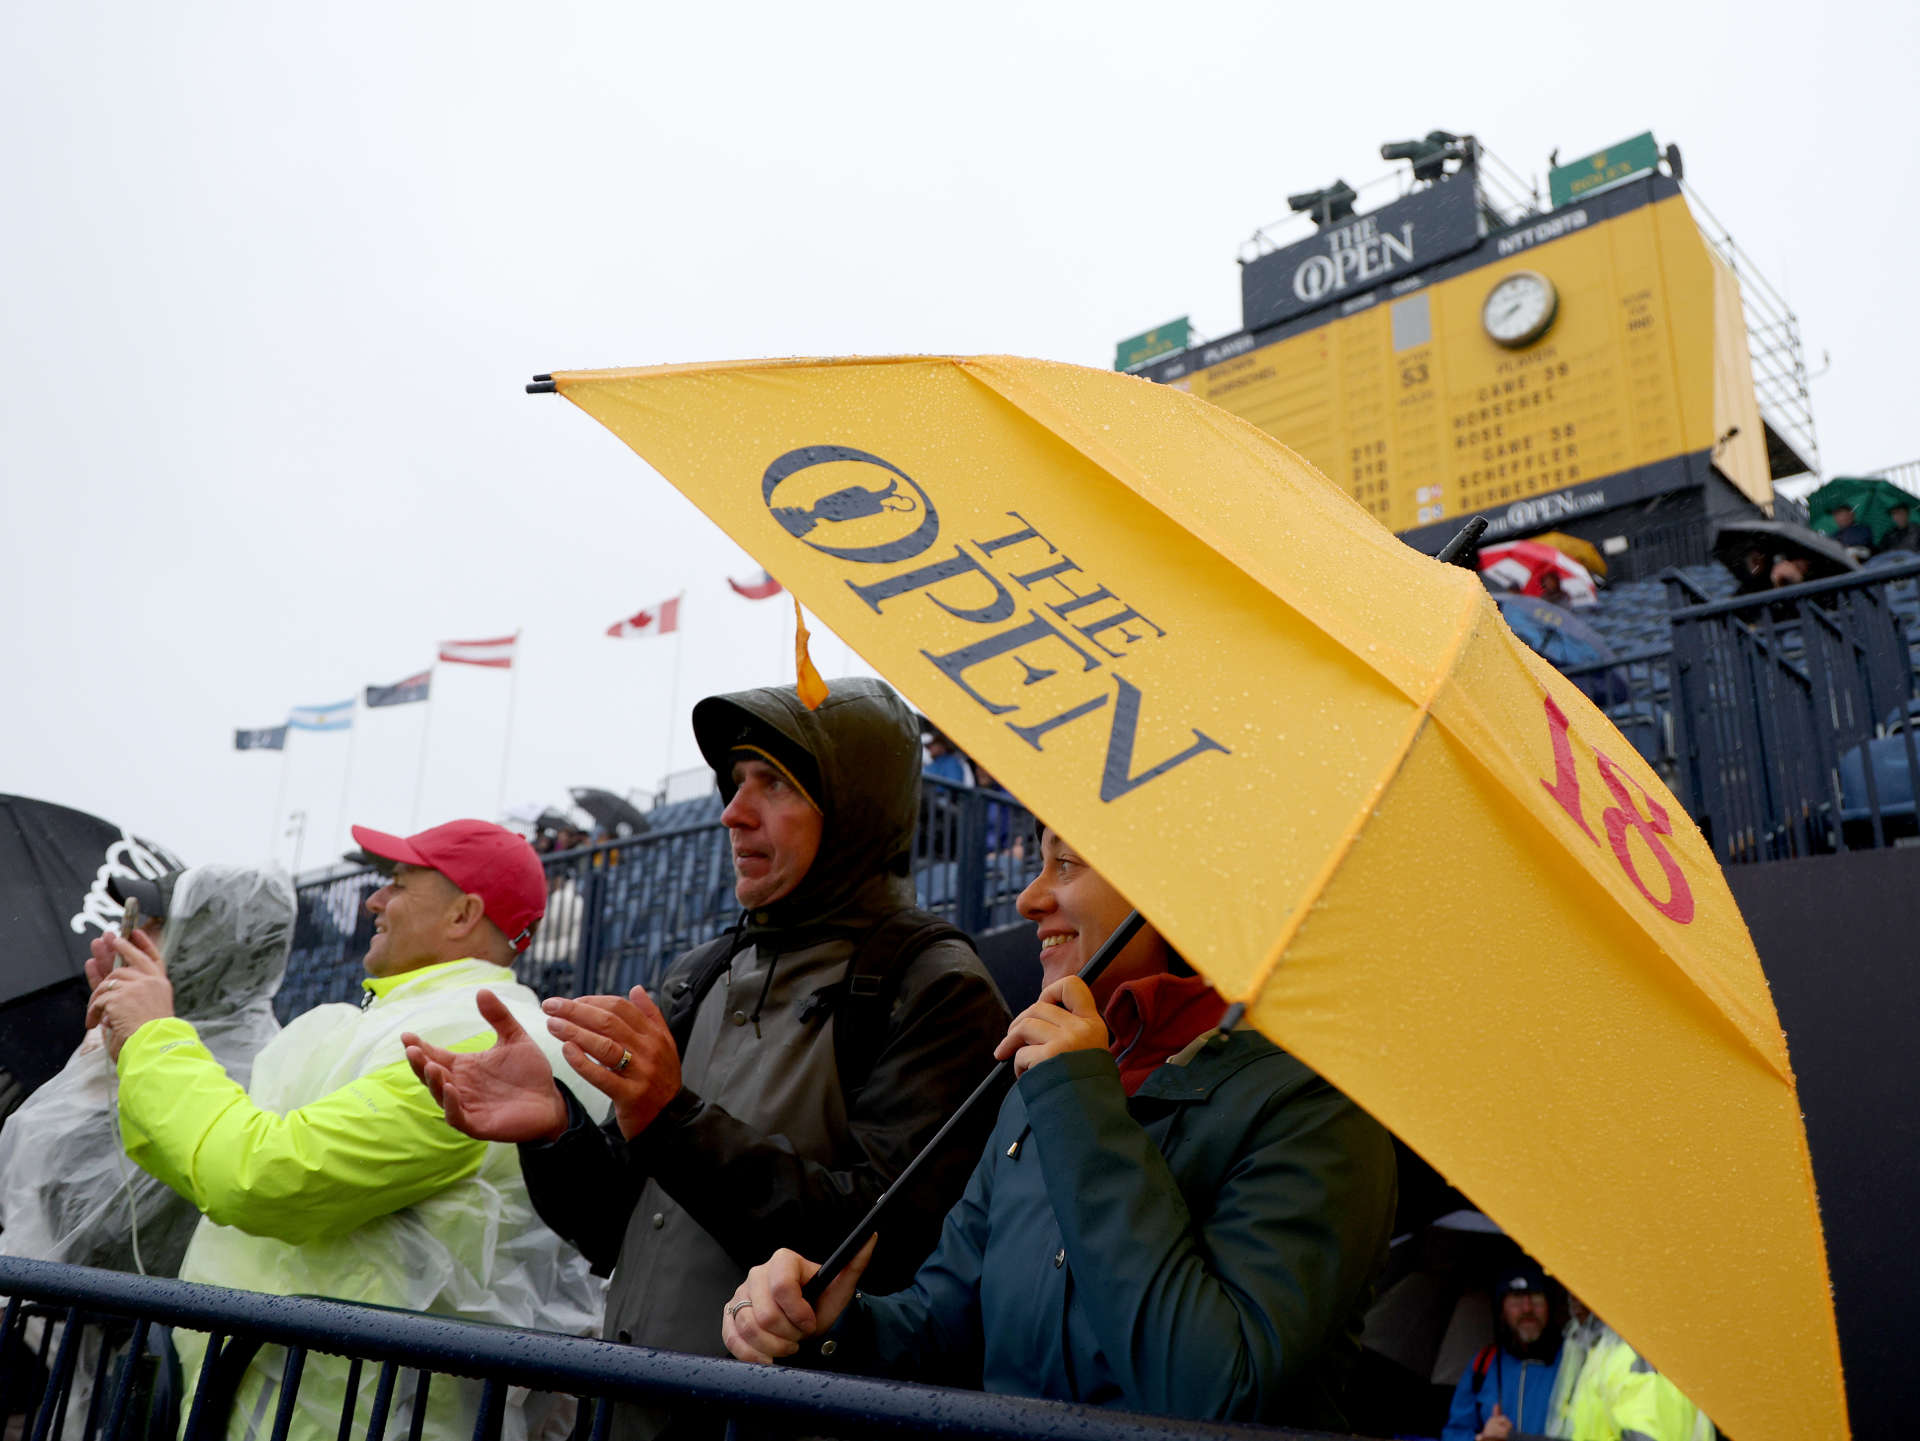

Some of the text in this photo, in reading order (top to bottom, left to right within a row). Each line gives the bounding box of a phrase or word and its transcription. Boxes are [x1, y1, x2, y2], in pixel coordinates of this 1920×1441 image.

[1327, 216, 1378, 252] THE
[1293, 222, 1414, 302] OPEN
[1453, 386, 1555, 429] HORSCHEL
[1456, 423, 1505, 449] ROSE
[1483, 435, 1533, 462] GAME
[1459, 443, 1578, 489] SCHEFFLER
[971, 511, 1167, 658] THE
[762, 445, 1232, 804] OPEN
[1537, 688, 1695, 925] 18
